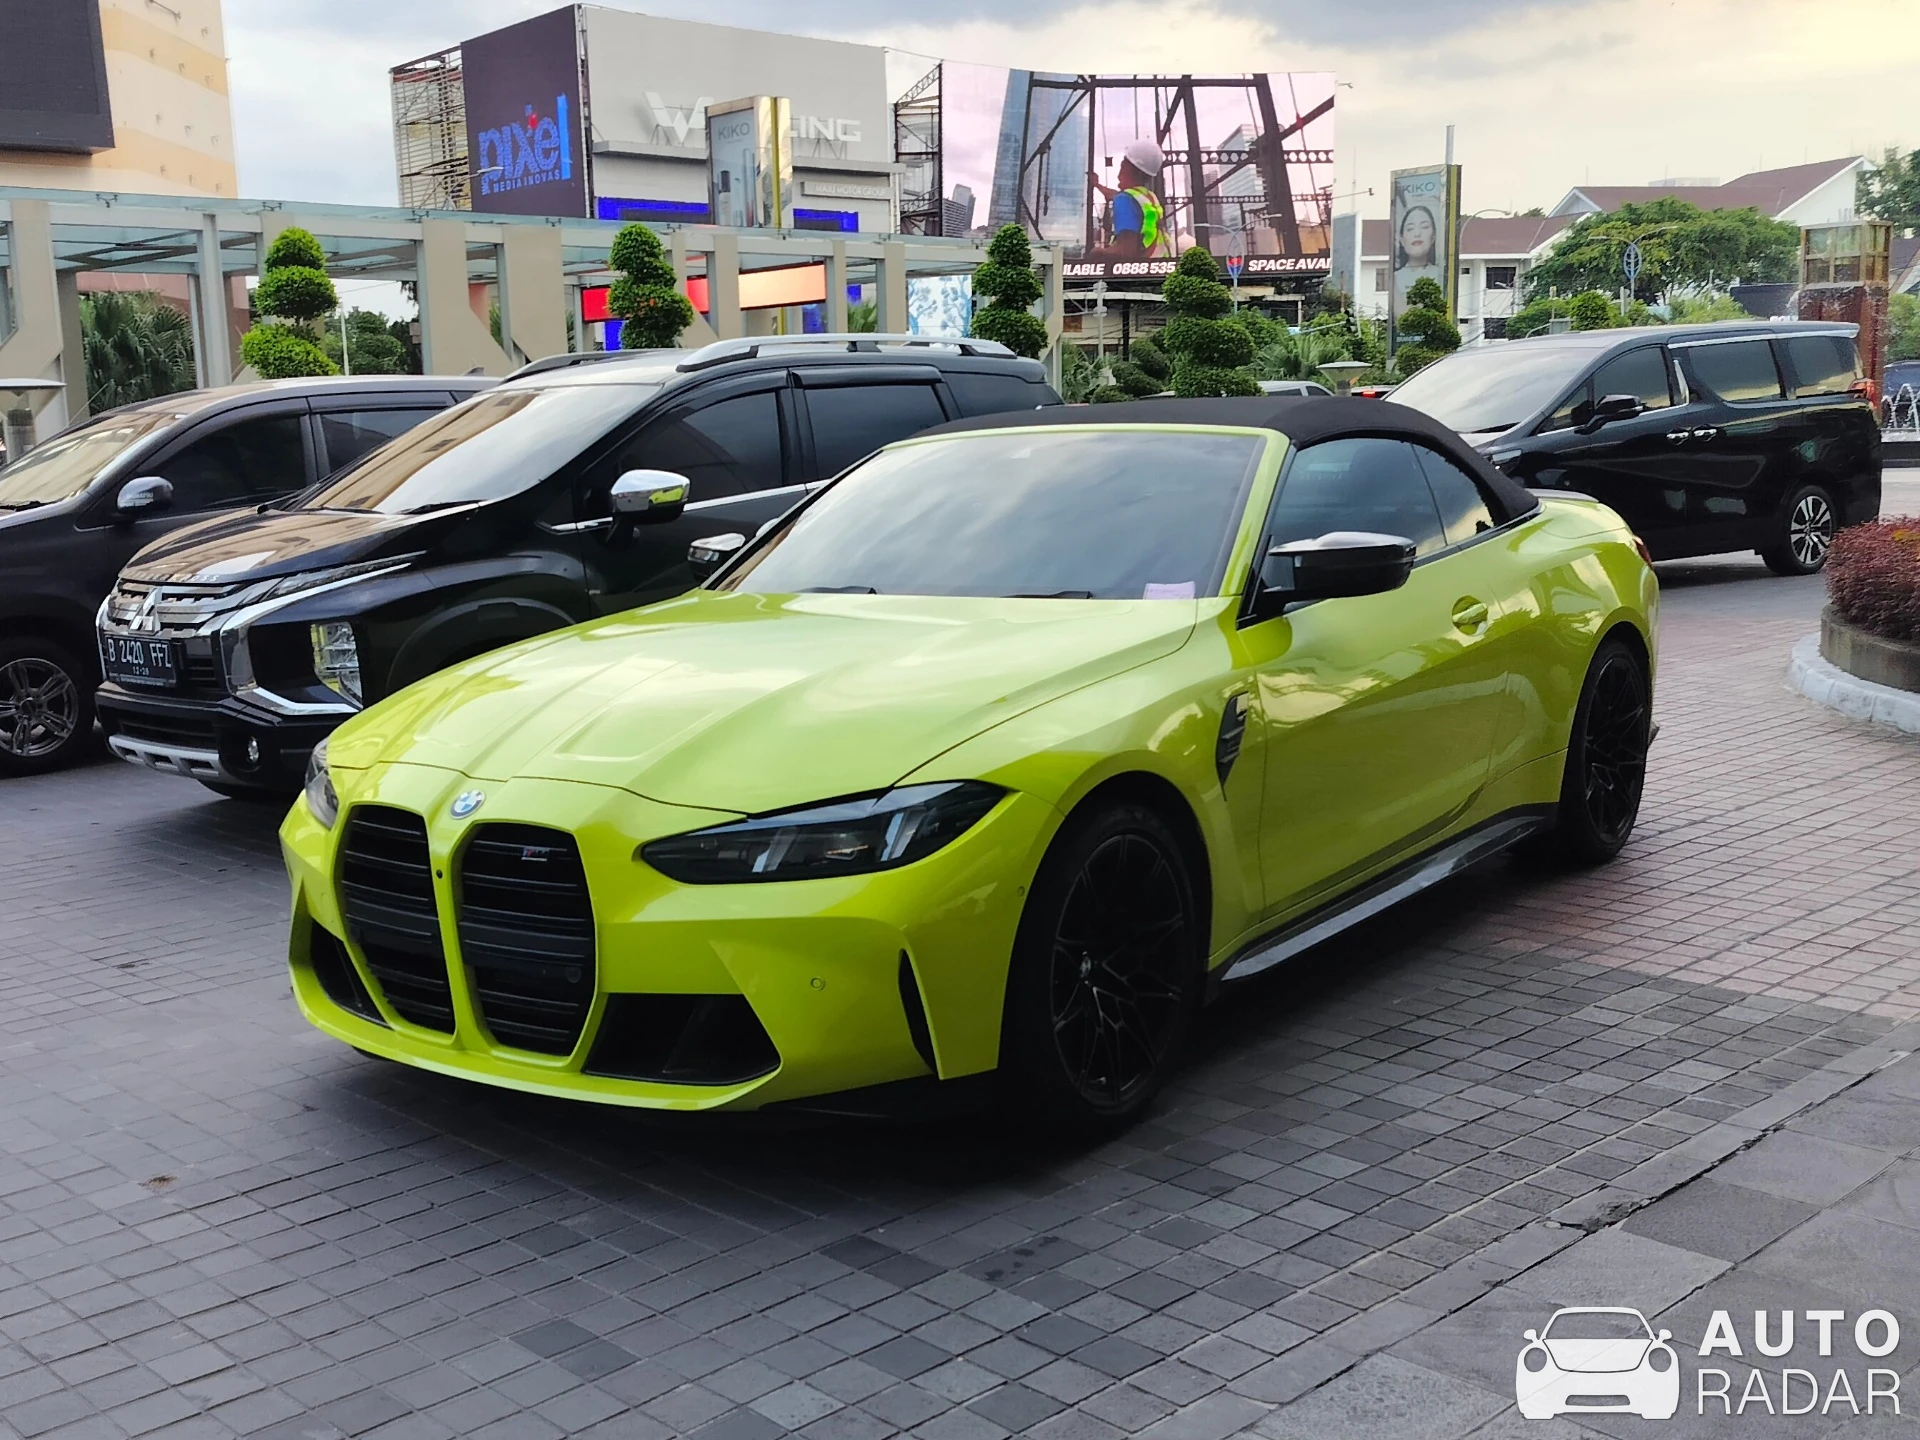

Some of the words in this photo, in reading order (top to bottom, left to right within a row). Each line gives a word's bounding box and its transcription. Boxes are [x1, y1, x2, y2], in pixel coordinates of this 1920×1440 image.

[718, 122, 751, 141] KIKO
[493, 179, 522, 193] MEDIA
[837, 185, 861, 196] MOTOR
[862, 186, 887, 197] GROUP
[1403, 181, 1436, 194] KIKO
[1112, 262, 1149, 275] 0888
[1248, 259, 1295, 271] SPACE
[108, 638, 116, 662] B
[119, 640, 144, 665] 2420
[149, 643, 172, 668] FFZ
